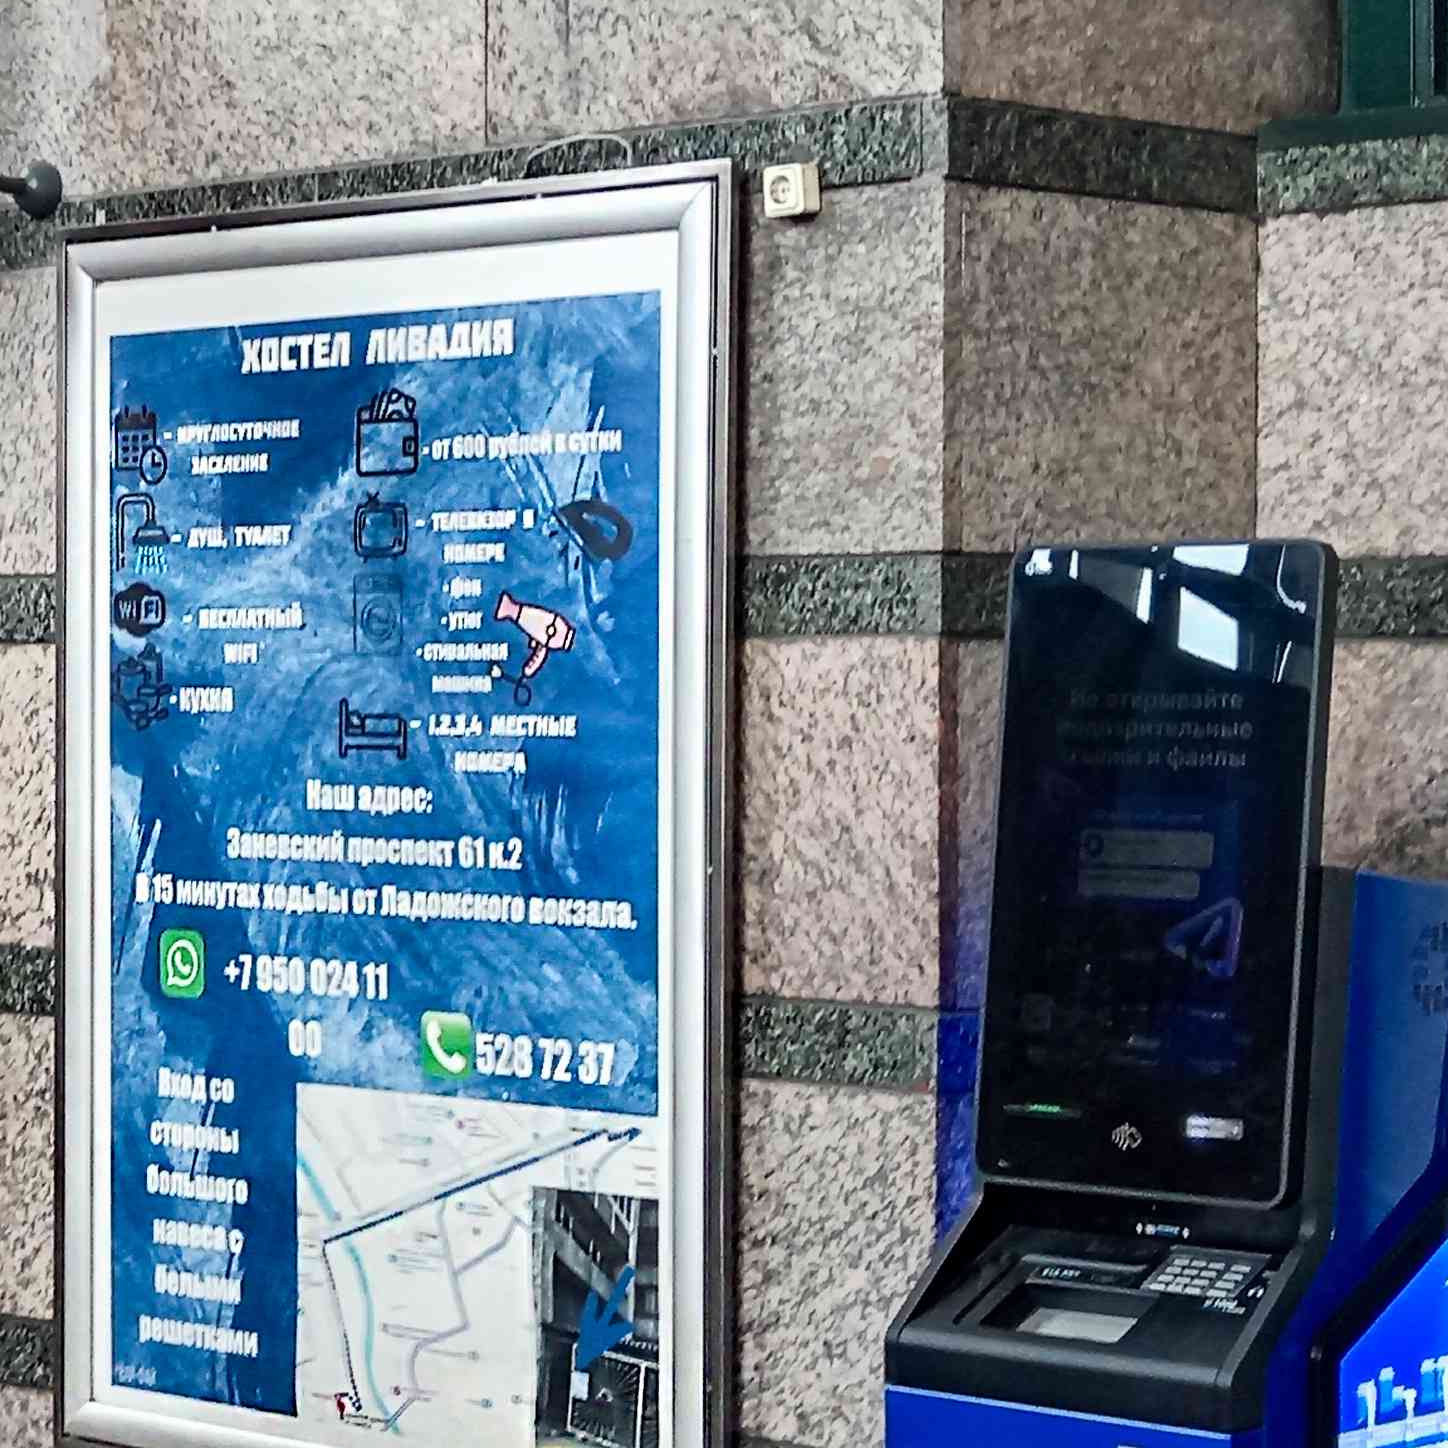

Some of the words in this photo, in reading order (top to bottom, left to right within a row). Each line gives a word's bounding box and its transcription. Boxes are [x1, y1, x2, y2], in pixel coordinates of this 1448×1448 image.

[241, 331, 351, 374] ХОСТЕЛ
[366, 318, 515, 365] ЛИВАДИЯ
[452, 434, 487, 459] 600
[234, 525, 292, 548] ТУАЛЕТ
[490, 714, 578, 737] МЕСТНЫЕ
[306, 778, 356, 811] Наш
[358, 785, 433, 816] адрес:
[227, 827, 345, 863] Заневский
[347, 836, 456, 868] проспект
[458, 835, 485, 869] 61
[153, 873, 174, 904] 15
[176, 879, 261, 910] минутах
[262, 880, 349, 915] ходьбы
[351, 888, 378, 916] от
[380, 884, 526, 923] Ладожского
[528, 896, 639, 930] вокзала.
[224, 953, 253, 991] +7
[256, 955, 306, 994] 950
[310, 958, 360, 998] 024
[362, 962, 390, 1000] 11
[287, 1019, 322, 1057] 00
[475, 1032, 534, 1078] 528
[538, 1036, 573, 1083] 72
[578, 1041, 616, 1086] 37
[158, 1066, 207, 1104] Вход
[209, 1076, 235, 1104] со
[146, 1163, 248, 1205] большого
